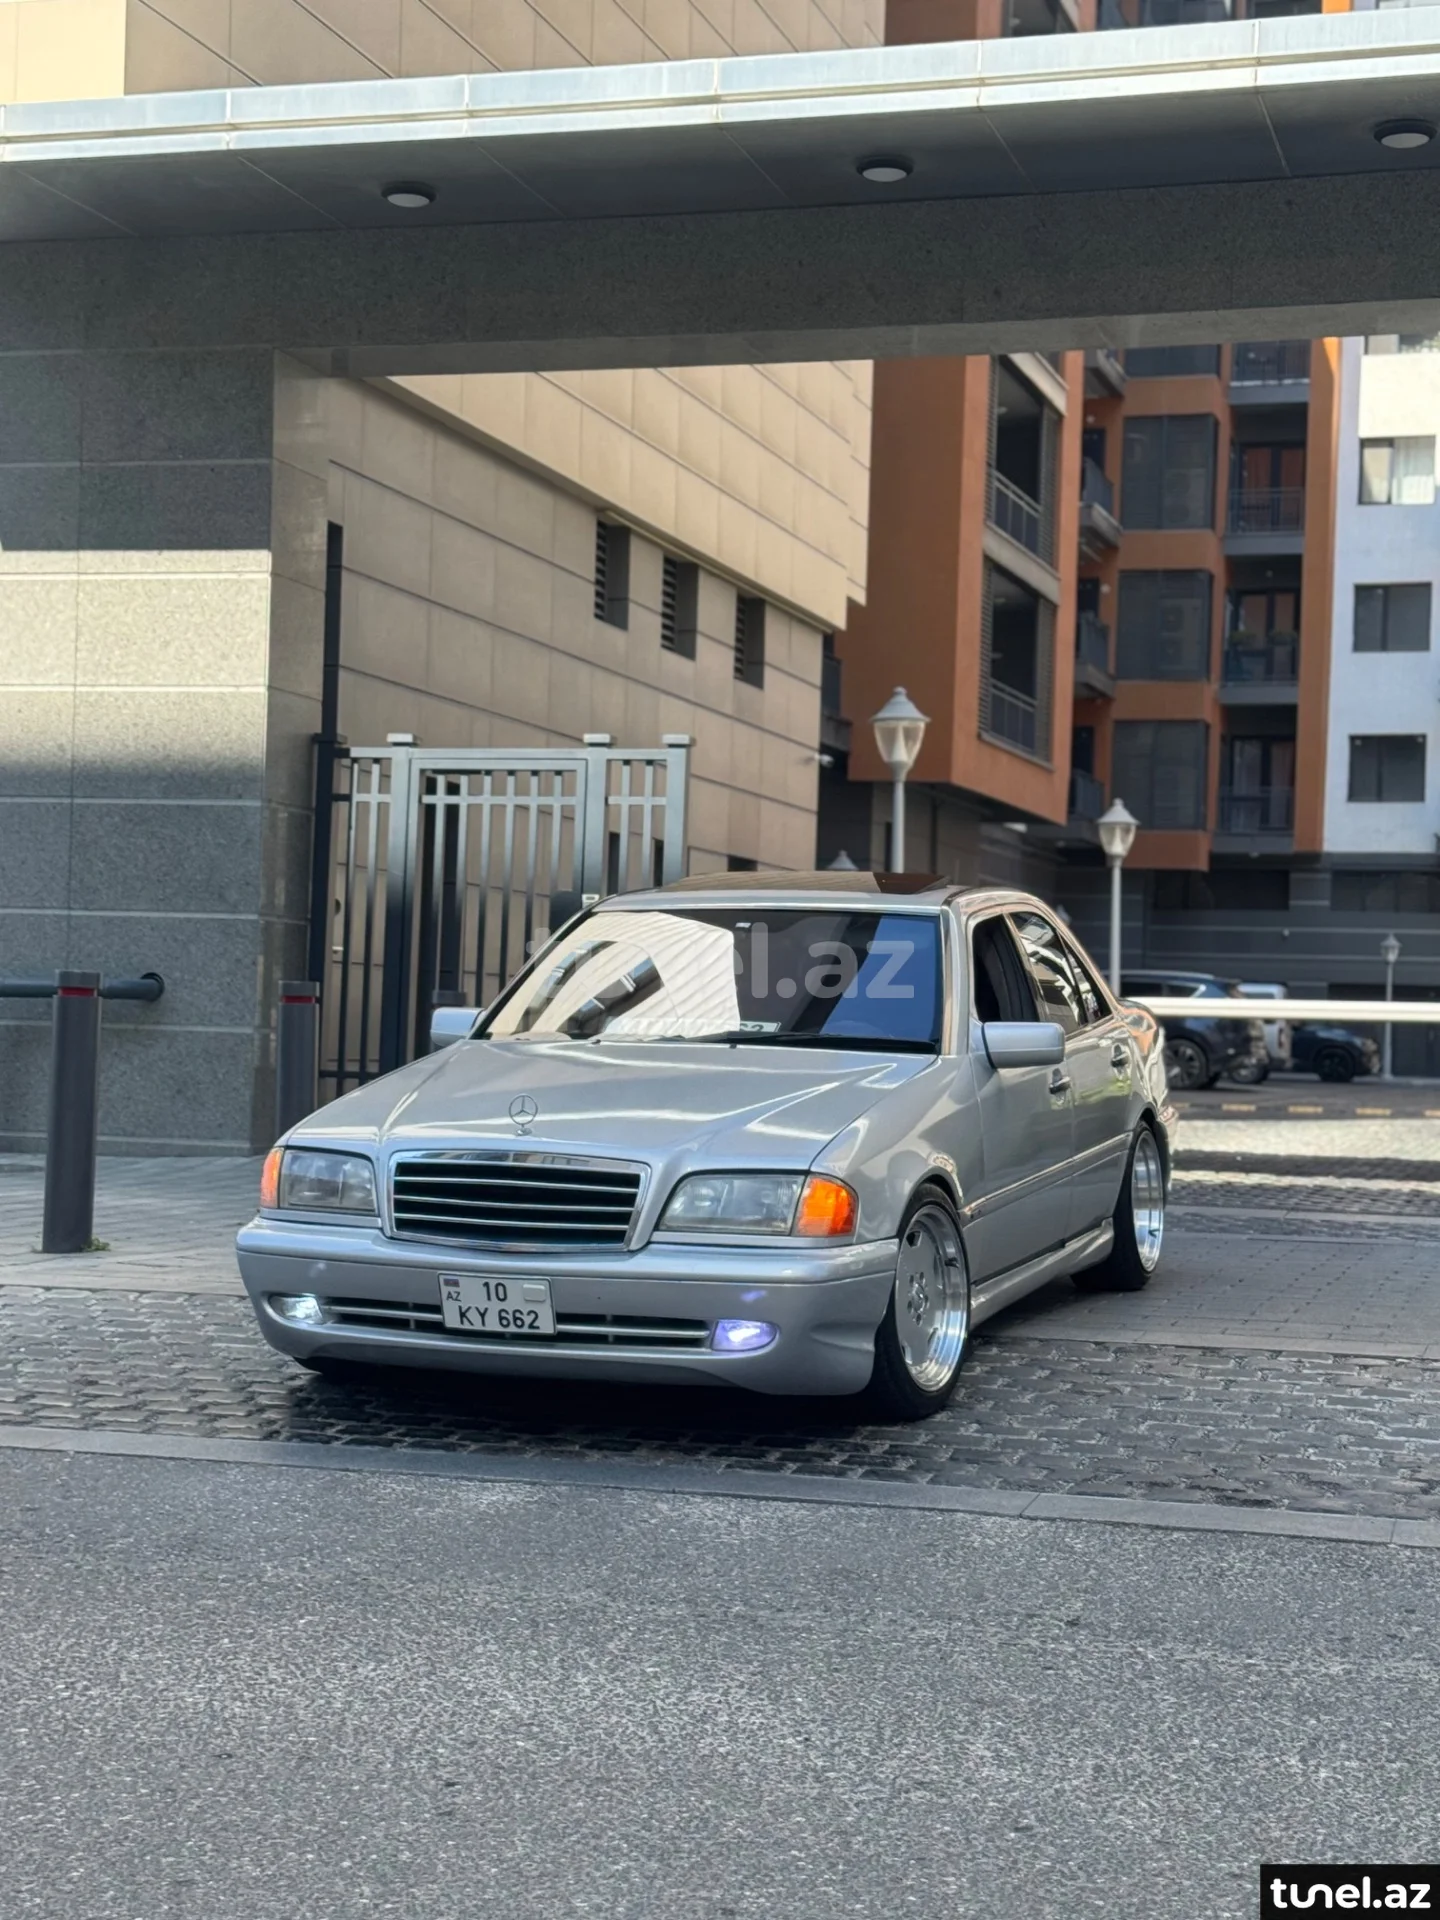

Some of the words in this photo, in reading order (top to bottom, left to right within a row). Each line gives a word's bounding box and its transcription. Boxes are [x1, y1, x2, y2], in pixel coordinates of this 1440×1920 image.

[446, 1291, 461, 1302] AZ
[482, 1281, 508, 1302] 10
[458, 1305, 489, 1327] KY
[498, 1308, 540, 1330] 662
